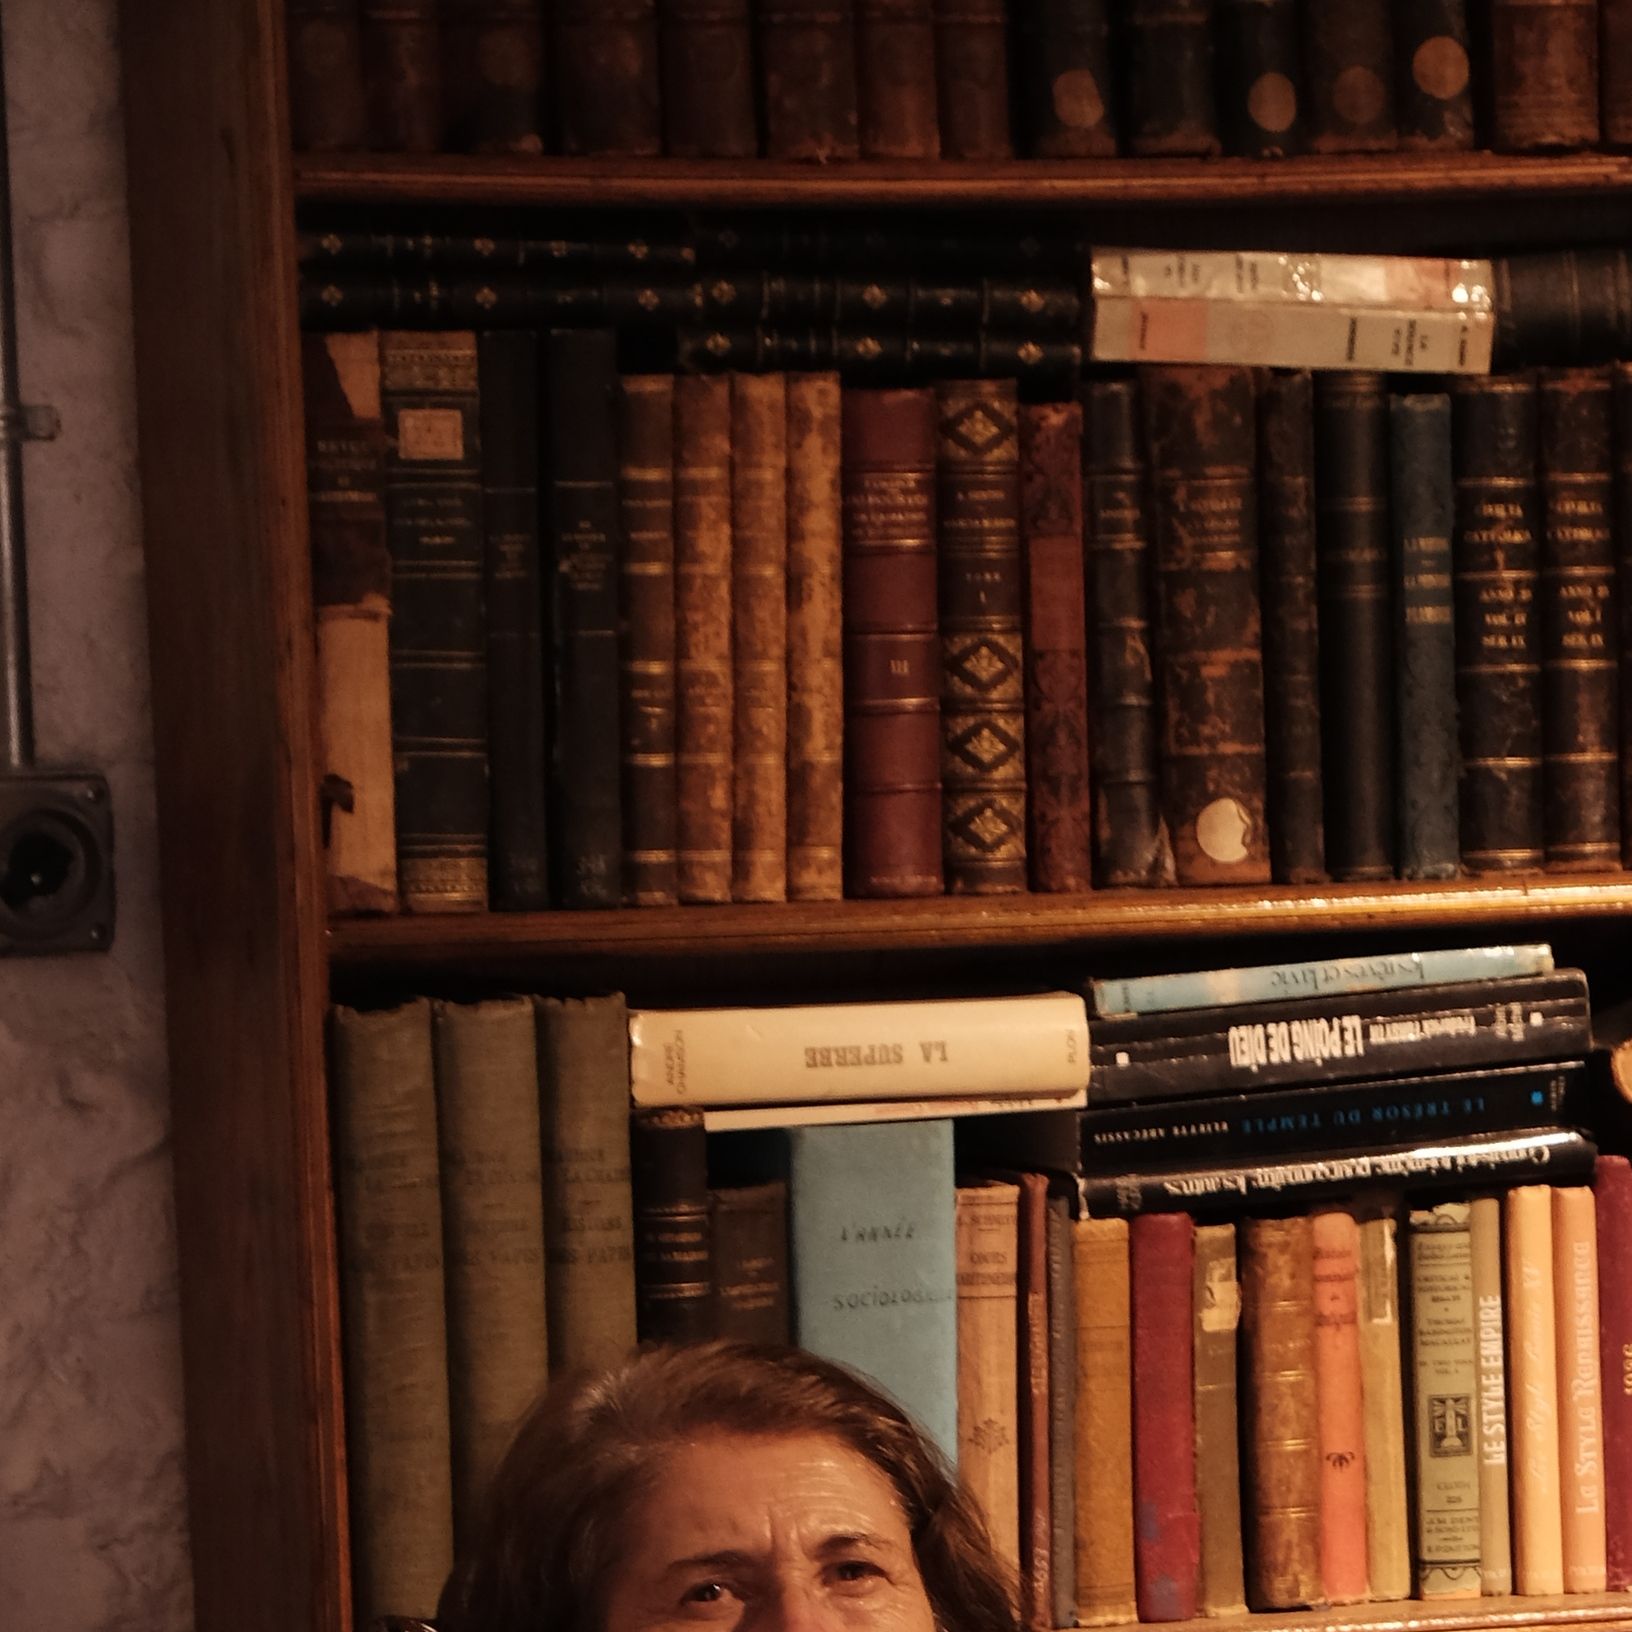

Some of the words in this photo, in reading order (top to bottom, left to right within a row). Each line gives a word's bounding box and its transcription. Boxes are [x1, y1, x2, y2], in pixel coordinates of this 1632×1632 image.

[1066, 1029, 1080, 1066] PLON
[1266, 1020, 1291, 1064] DE
[1341, 1014, 1365, 1058] LE
[804, 1044, 904, 1069] SUPERBE
[919, 1041, 950, 1064] LA
[1333, 1107, 1362, 1126] DU
[1463, 1096, 1486, 1114] LE
[1241, 1112, 1323, 1134] TEMPLE
[1480, 1295, 1503, 1369] EMPIRE
[1481, 1375, 1505, 1437] STYLE
[1484, 1440, 1506, 1466] LE
